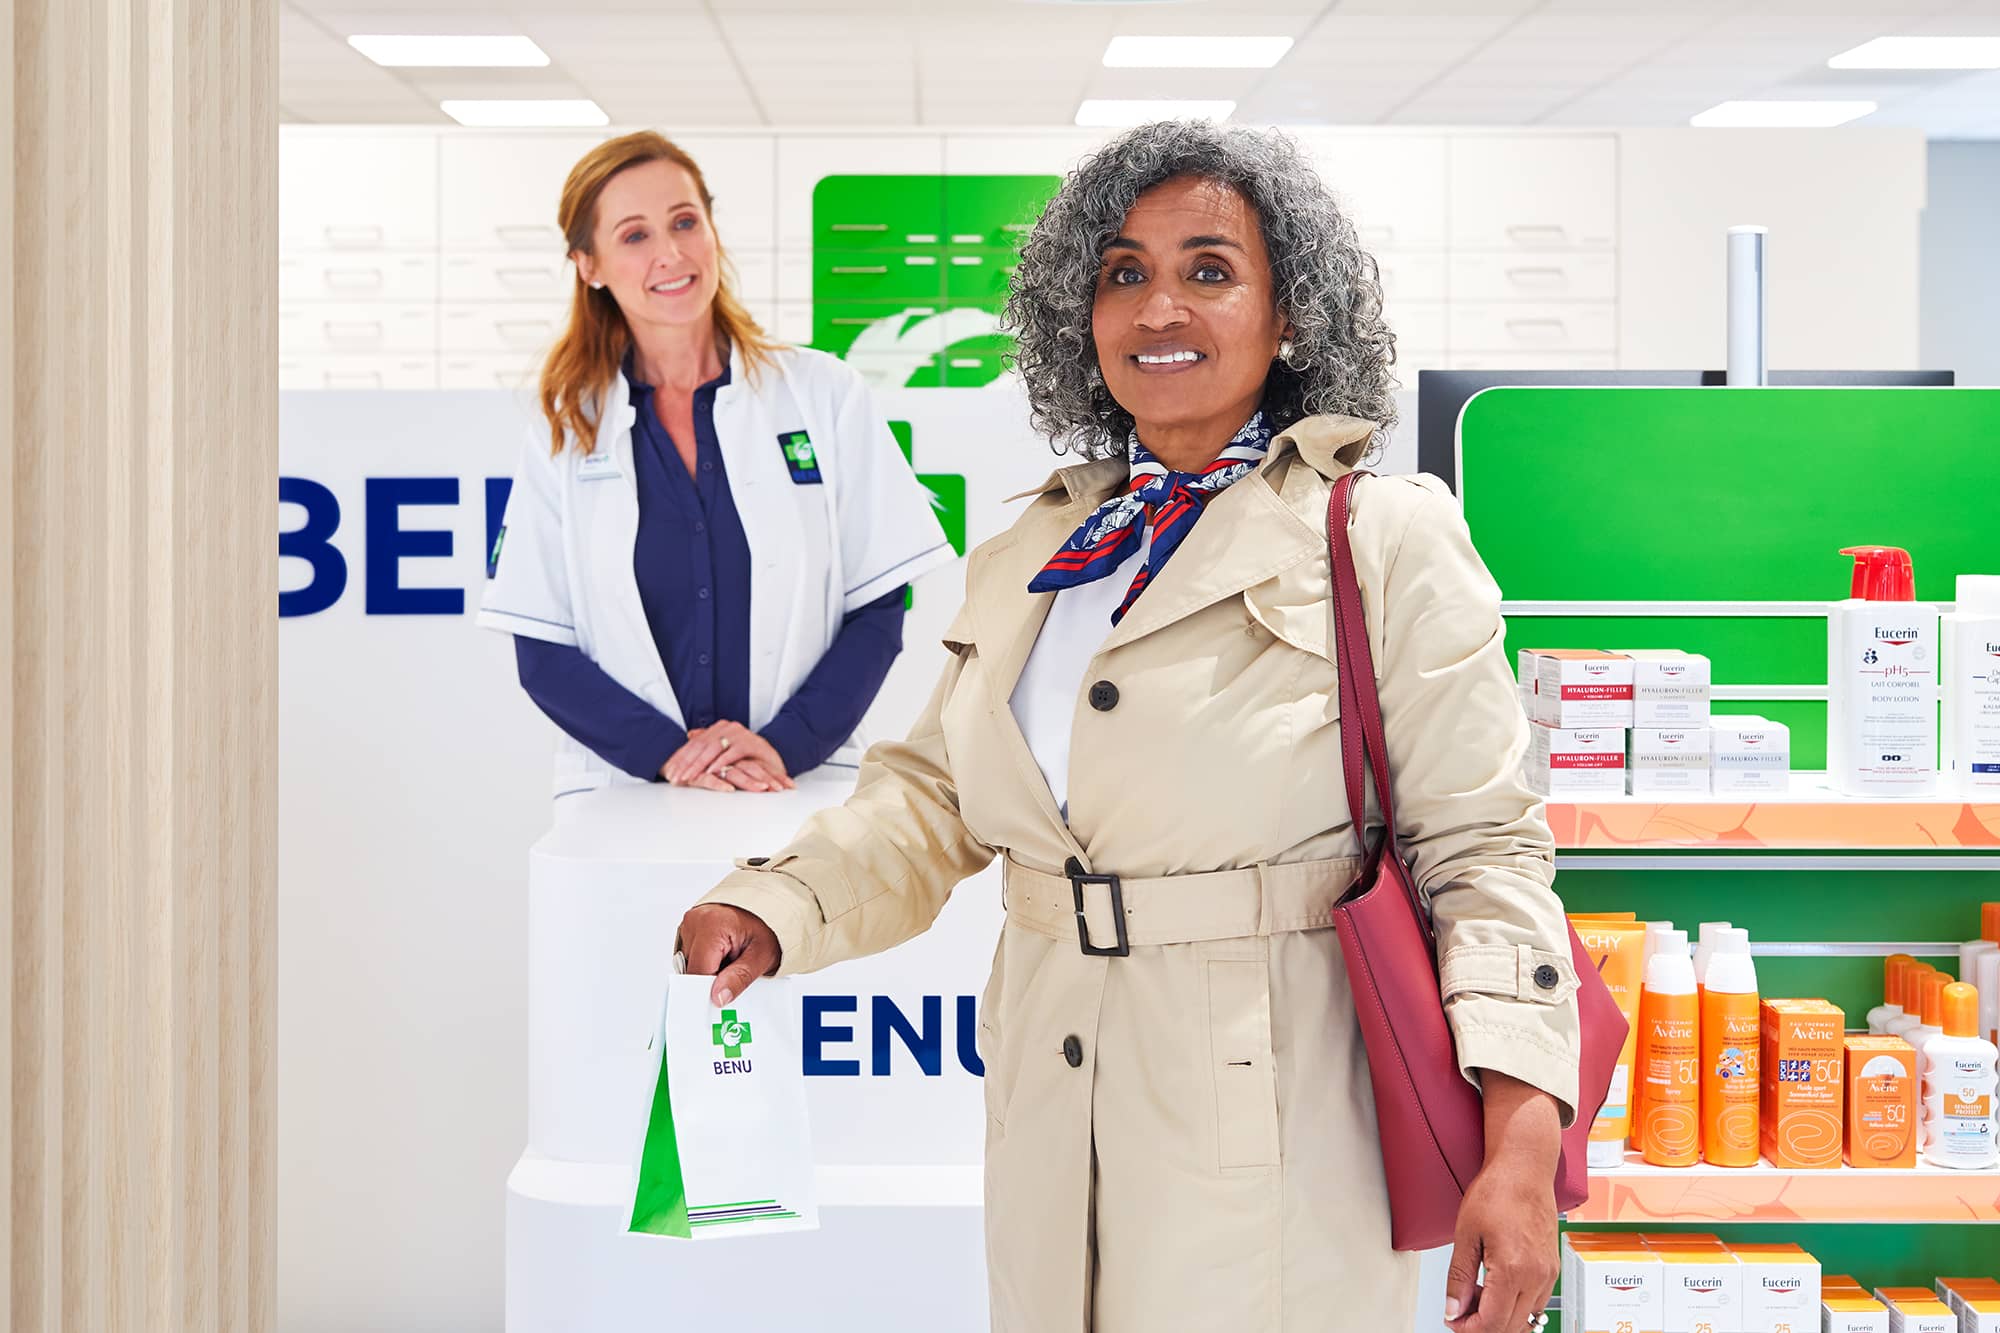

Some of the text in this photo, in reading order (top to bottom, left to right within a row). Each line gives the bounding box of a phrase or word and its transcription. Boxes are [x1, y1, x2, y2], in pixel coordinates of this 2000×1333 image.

[1874, 627, 1919, 639] Eucerin
[1574, 732, 1600, 740] Eucerin
[1659, 732, 1684, 740] Eucerin
[1653, 1024, 1693, 1039] Avène
[1791, 1027, 1834, 1040] Avène
[713, 1060, 752, 1075] BENU
[1955, 1060, 1982, 1068] Eucerin
[1962, 1087, 1975, 1097] 50
[1604, 1275, 1643, 1286] Eucerin
[1683, 1277, 1722, 1288] Eucerin
[1762, 1277, 1801, 1288] Eucerin
[1616, 1321, 1633, 1333] 25
[1695, 1323, 1712, 1333] 25
[1774, 1323, 1791, 1333] 25
[1847, 1324, 1874, 1332] Eucerin
[1919, 1324, 1945, 1332] Eucerin
